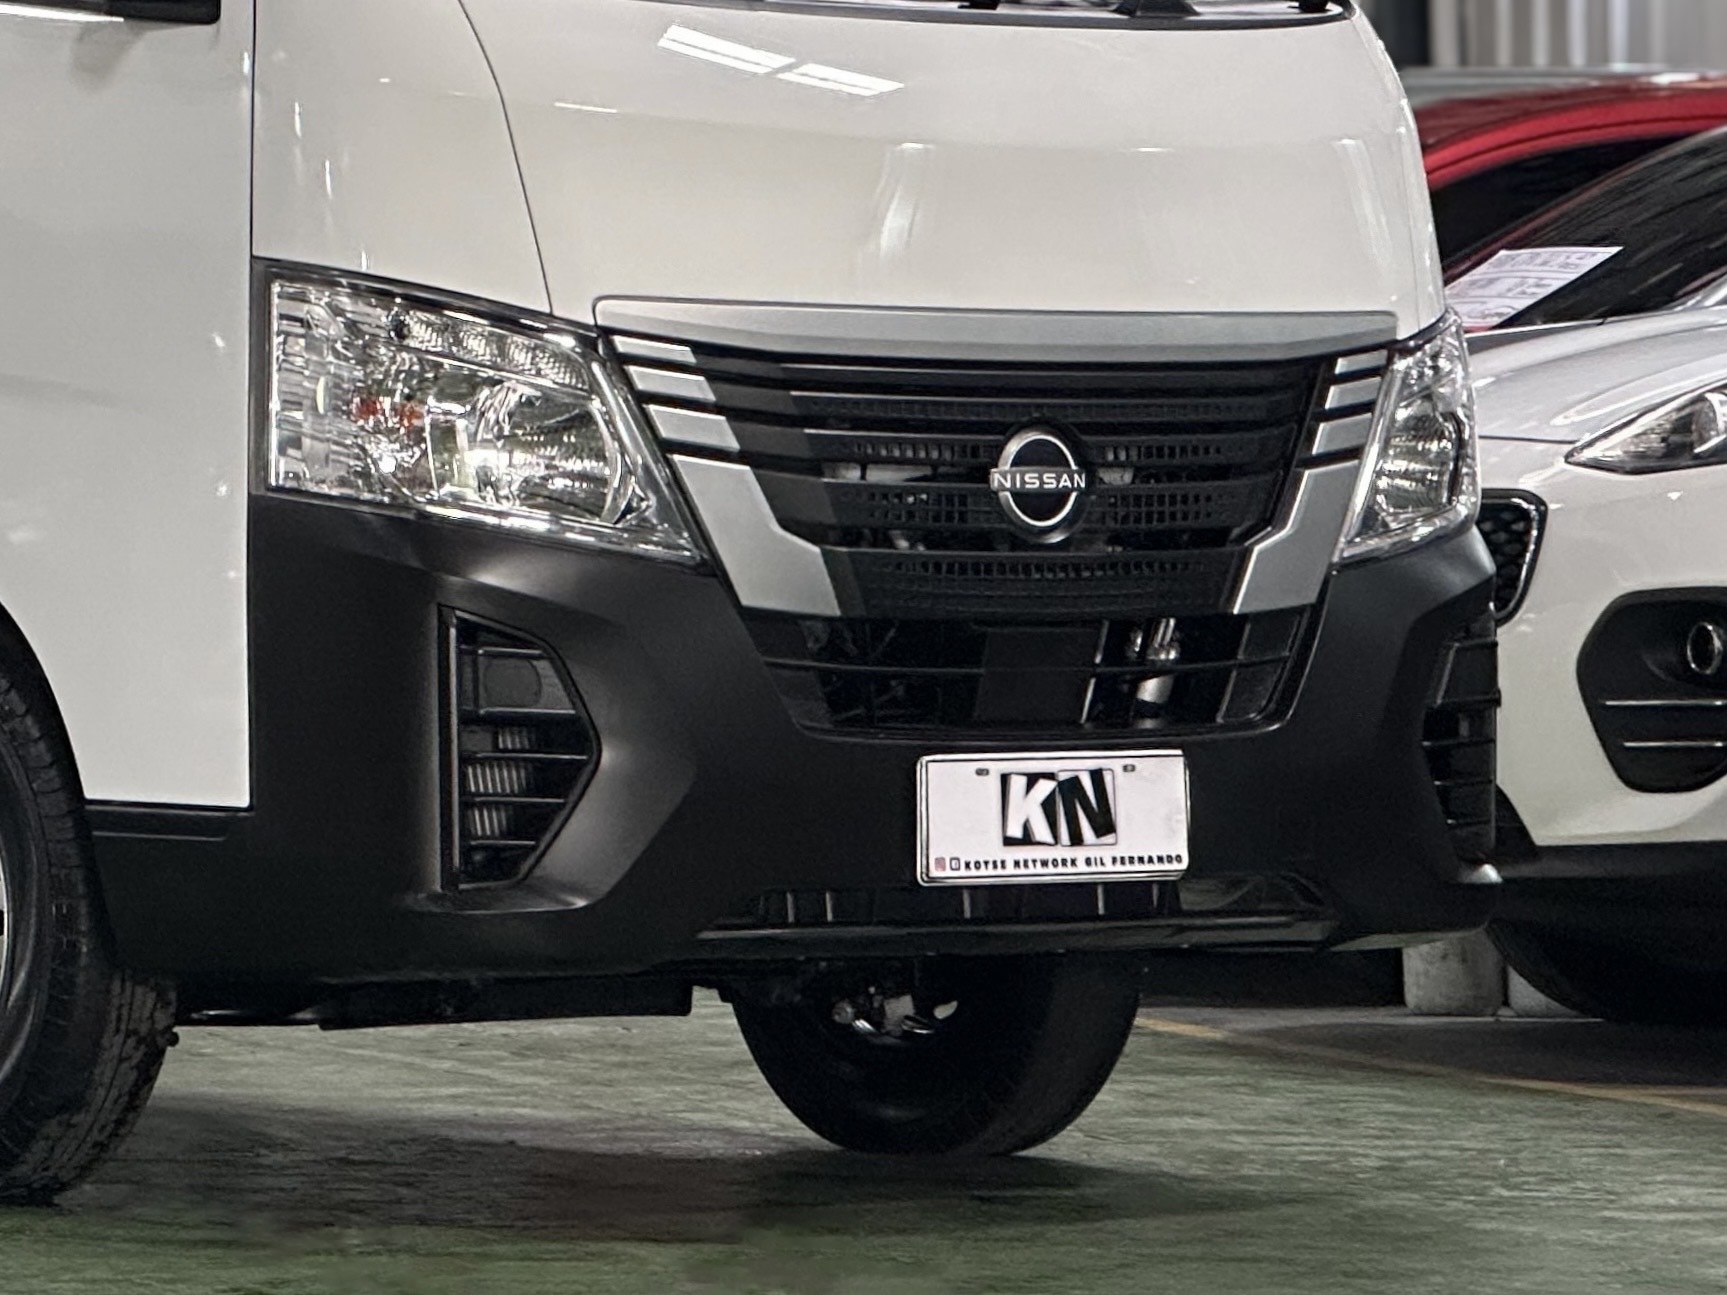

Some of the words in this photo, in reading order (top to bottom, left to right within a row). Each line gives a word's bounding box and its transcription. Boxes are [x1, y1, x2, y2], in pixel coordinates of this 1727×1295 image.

[993, 472, 1086, 489] NISSAN
[1005, 768, 1116, 846] KN
[964, 861, 1008, 871] KOTSE
[1012, 859, 1078, 869] NETWORK
[1084, 856, 1106, 867] GIL
[1111, 854, 1183, 866] FERNANDO
